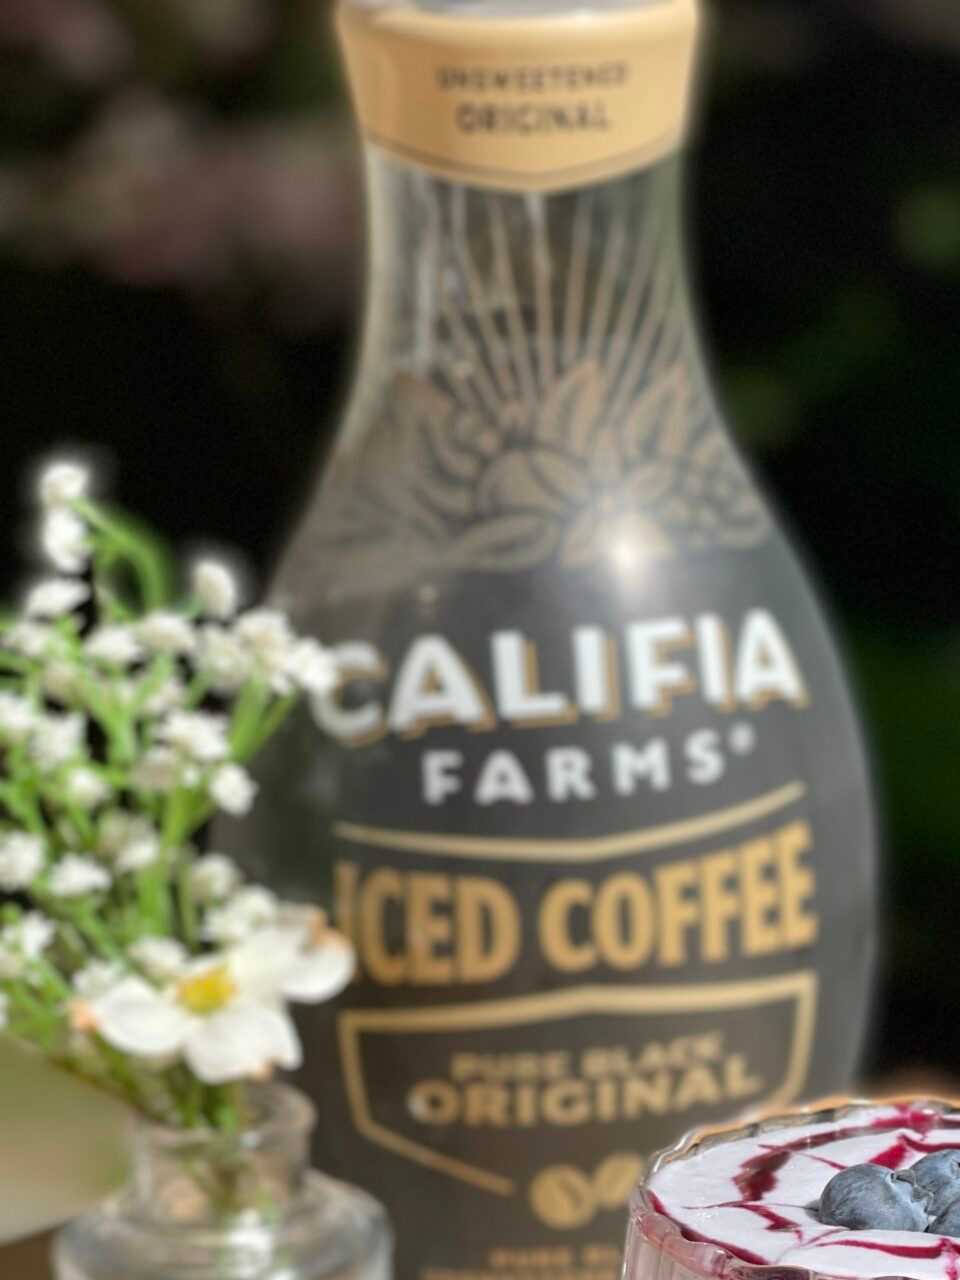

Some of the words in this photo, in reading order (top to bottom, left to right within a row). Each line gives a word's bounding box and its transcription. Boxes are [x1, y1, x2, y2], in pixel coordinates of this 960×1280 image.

[456, 101, 609, 134] ORIGINAL
[310, 608, 810, 748] CALIFIA
[333, 861, 521, 987] ICED
[538, 820, 818, 973] COFFEE
[580, 1030, 724, 1076] BLACK
[408, 1055, 762, 1127] ORIGINAL
